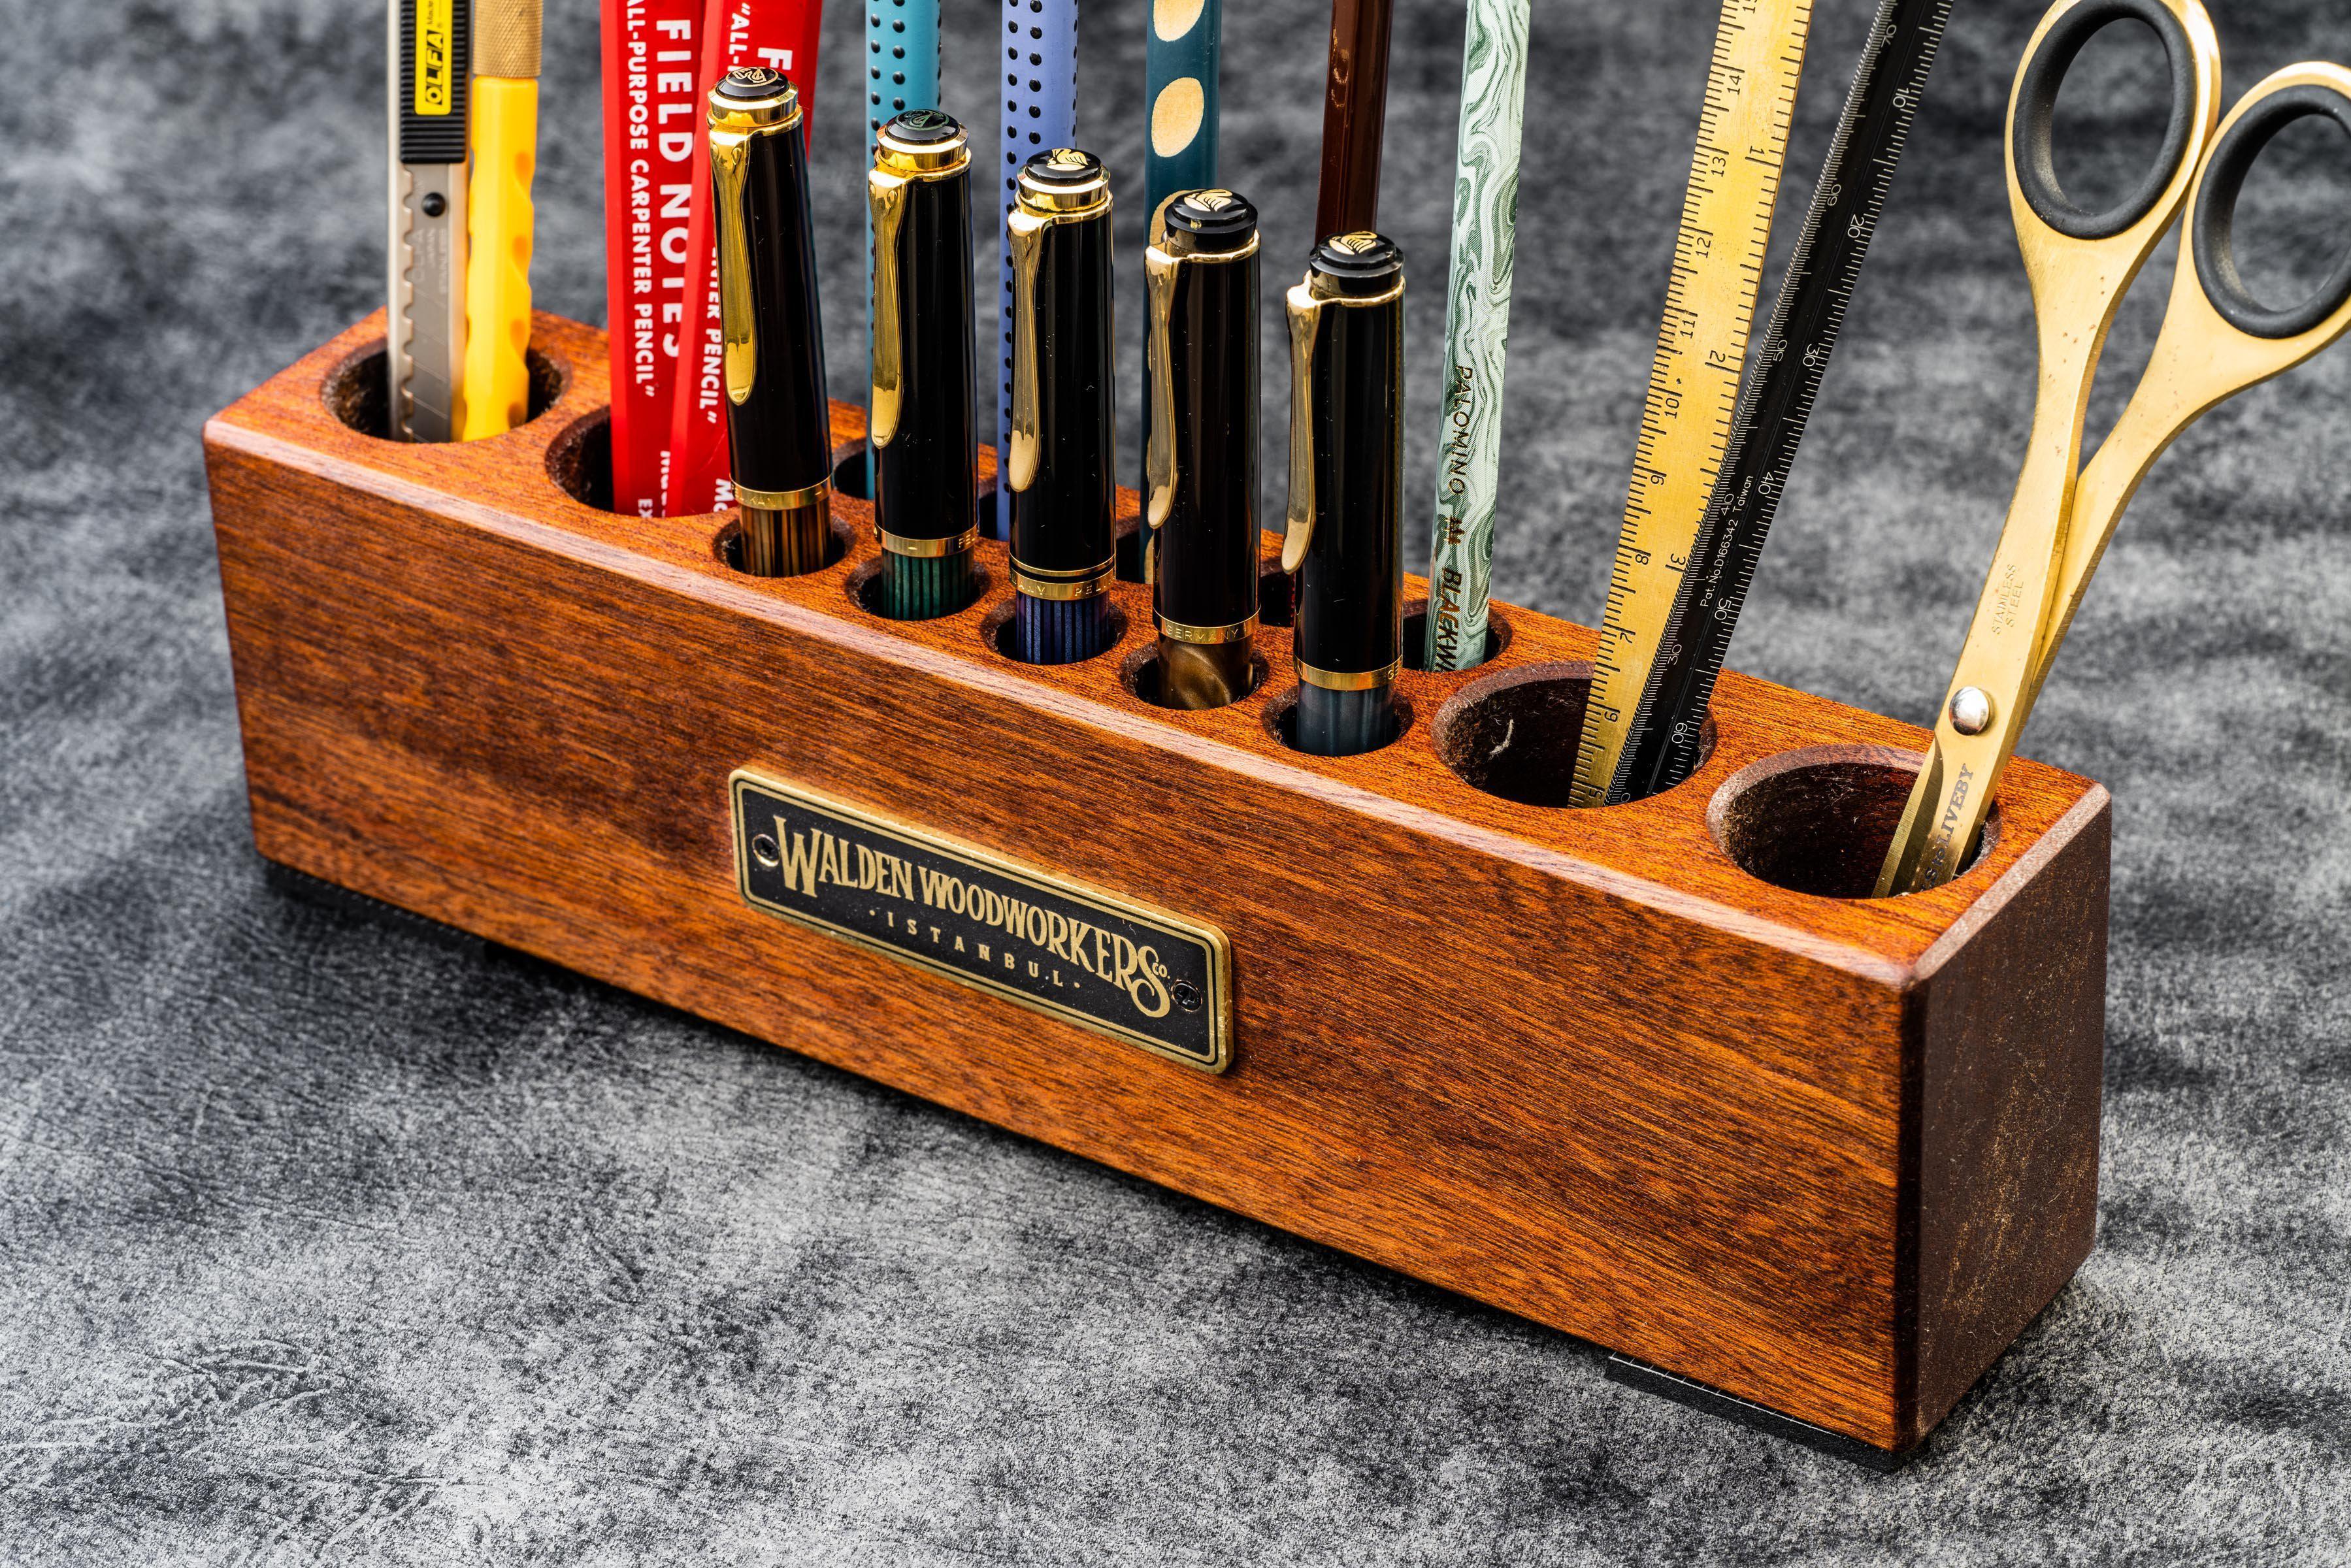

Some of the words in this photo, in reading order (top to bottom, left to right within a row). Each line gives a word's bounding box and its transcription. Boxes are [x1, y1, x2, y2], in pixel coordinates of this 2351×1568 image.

[1742, 0, 1758, 14] 1
[1881, 24, 1897, 48] 70
[425, 29, 444, 106] OLFA
[656, 20, 693, 162] FIELD
[1726, 74, 1742, 95] 14
[1892, 88, 1910, 108] 10
[1749, 145, 1766, 155] 1
[1711, 155, 1726, 178] 13
[1826, 184, 1842, 206] 60
[630, 159, 652, 294] CARPENTER
[1847, 214, 1865, 238] 20
[1695, 237, 1711, 259] 12
[1679, 319, 1696, 339] 11
[1709, 350, 1726, 363] 2
[1772, 339, 1788, 362] 50
[1802, 343, 1820, 368] 30
[1664, 397, 1680, 419] 10
[1449, 365, 1473, 495] PALOMINO
[1650, 474, 1665, 485] 9
[1758, 471, 1774, 495] 40
[1720, 493, 1735, 516] 40
[1732, 475, 1754, 513] Taiwan
[1635, 553, 1649, 566] 8
[1670, 553, 1686, 566] 3
[1714, 597, 1732, 621] 50
[1991, 564, 2016, 635] STAINLESS
[2005, 581, 2024, 628] STEEL
[1165, 625, 1239, 643] GERMANY
[1619, 632, 1633, 644] 7
[1667, 644, 1683, 666] 30
[1603, 711, 1619, 723] 6
[1671, 722, 1688, 744] 60
[1588, 787, 1602, 800] 5
[1936, 763, 1974, 848] LIVEBY
[773, 815, 915, 902] WALDEN
[917, 865, 1171, 1019] WOODWORKERS
[887, 911, 1064, 987] ISTANBUL
